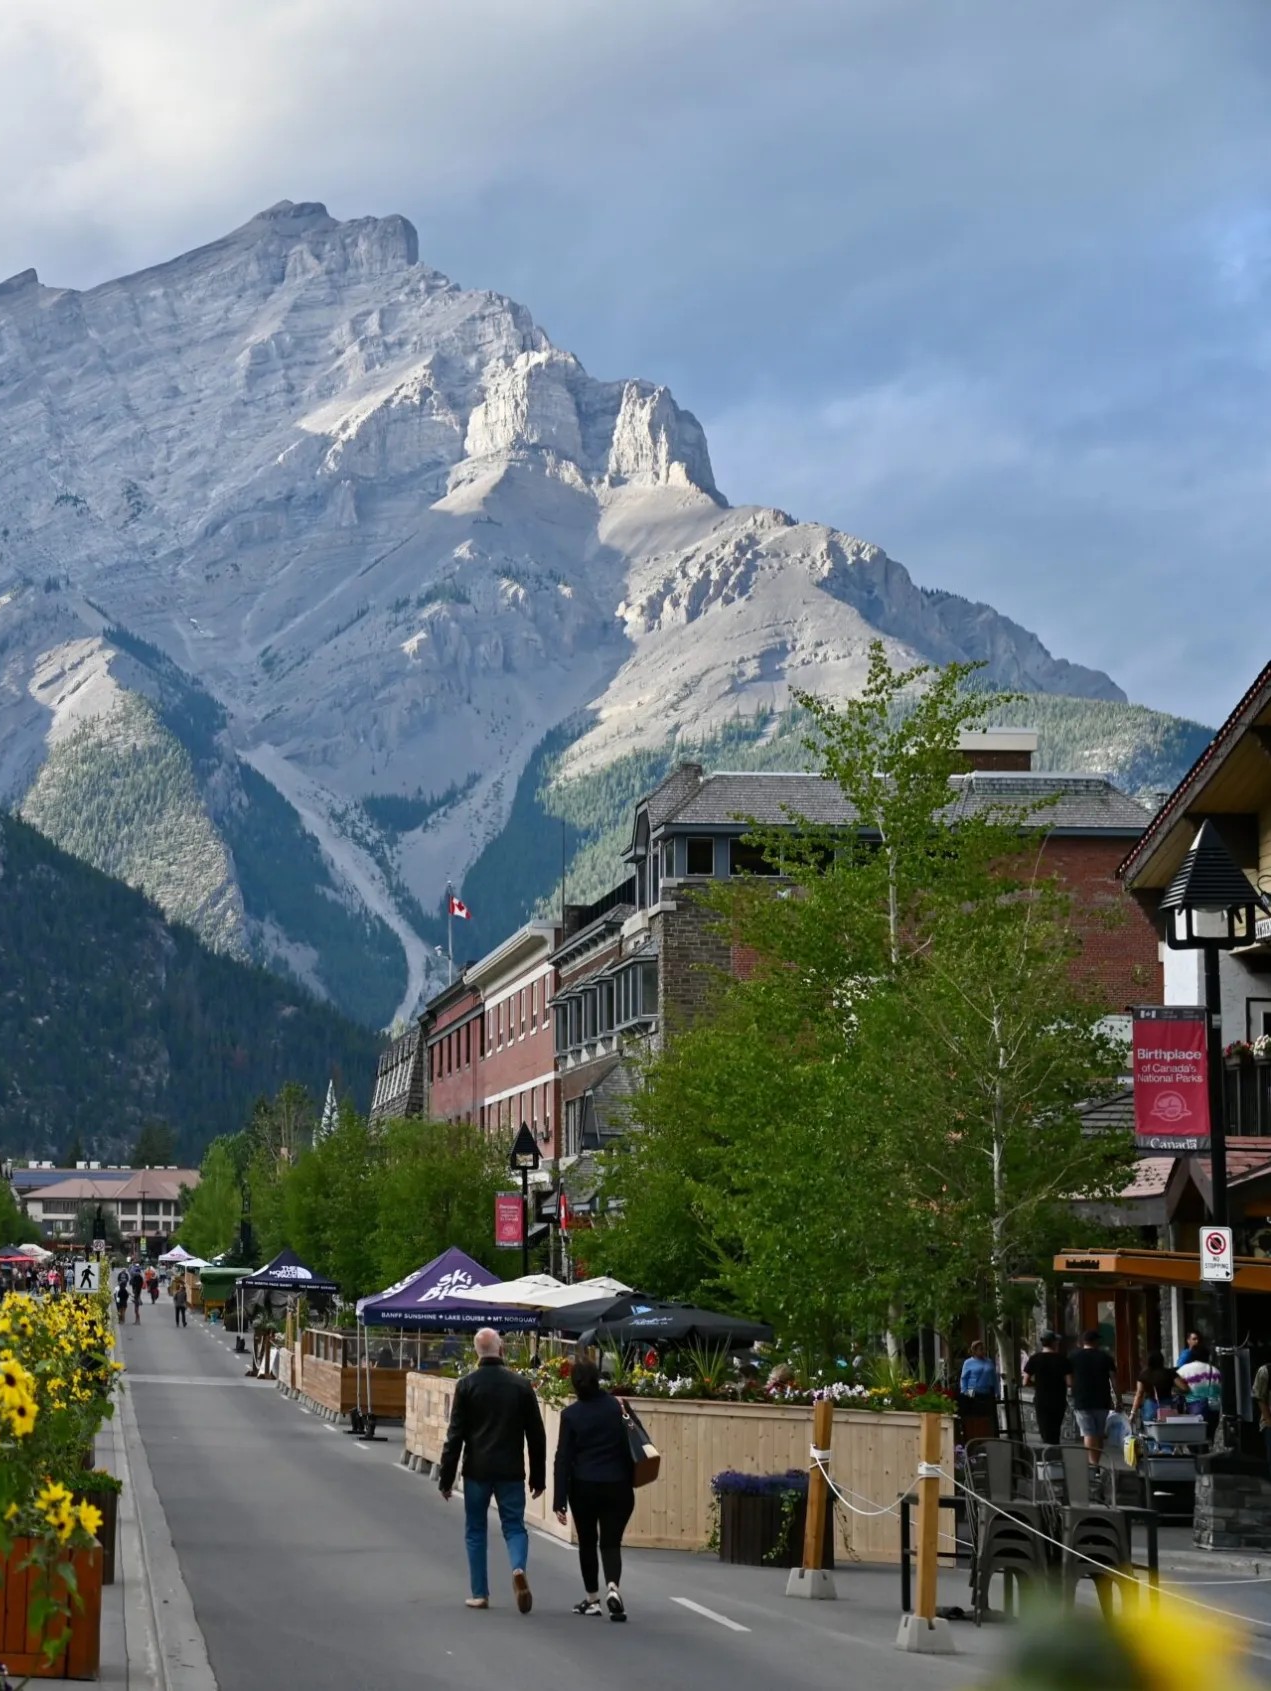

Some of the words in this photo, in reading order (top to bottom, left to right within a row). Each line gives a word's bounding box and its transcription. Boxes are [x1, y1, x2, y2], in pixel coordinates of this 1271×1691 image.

[1137, 1048, 1203, 1061] Birthplace
[1141, 1063, 1151, 1073] of
[1152, 1063, 1197, 1073] Canada's
[1137, 1073, 1174, 1083] National
[1175, 1073, 1203, 1083] Parks
[1150, 1137, 1198, 1150] Canada
[404, 1312, 437, 1320] SUNSHINE
